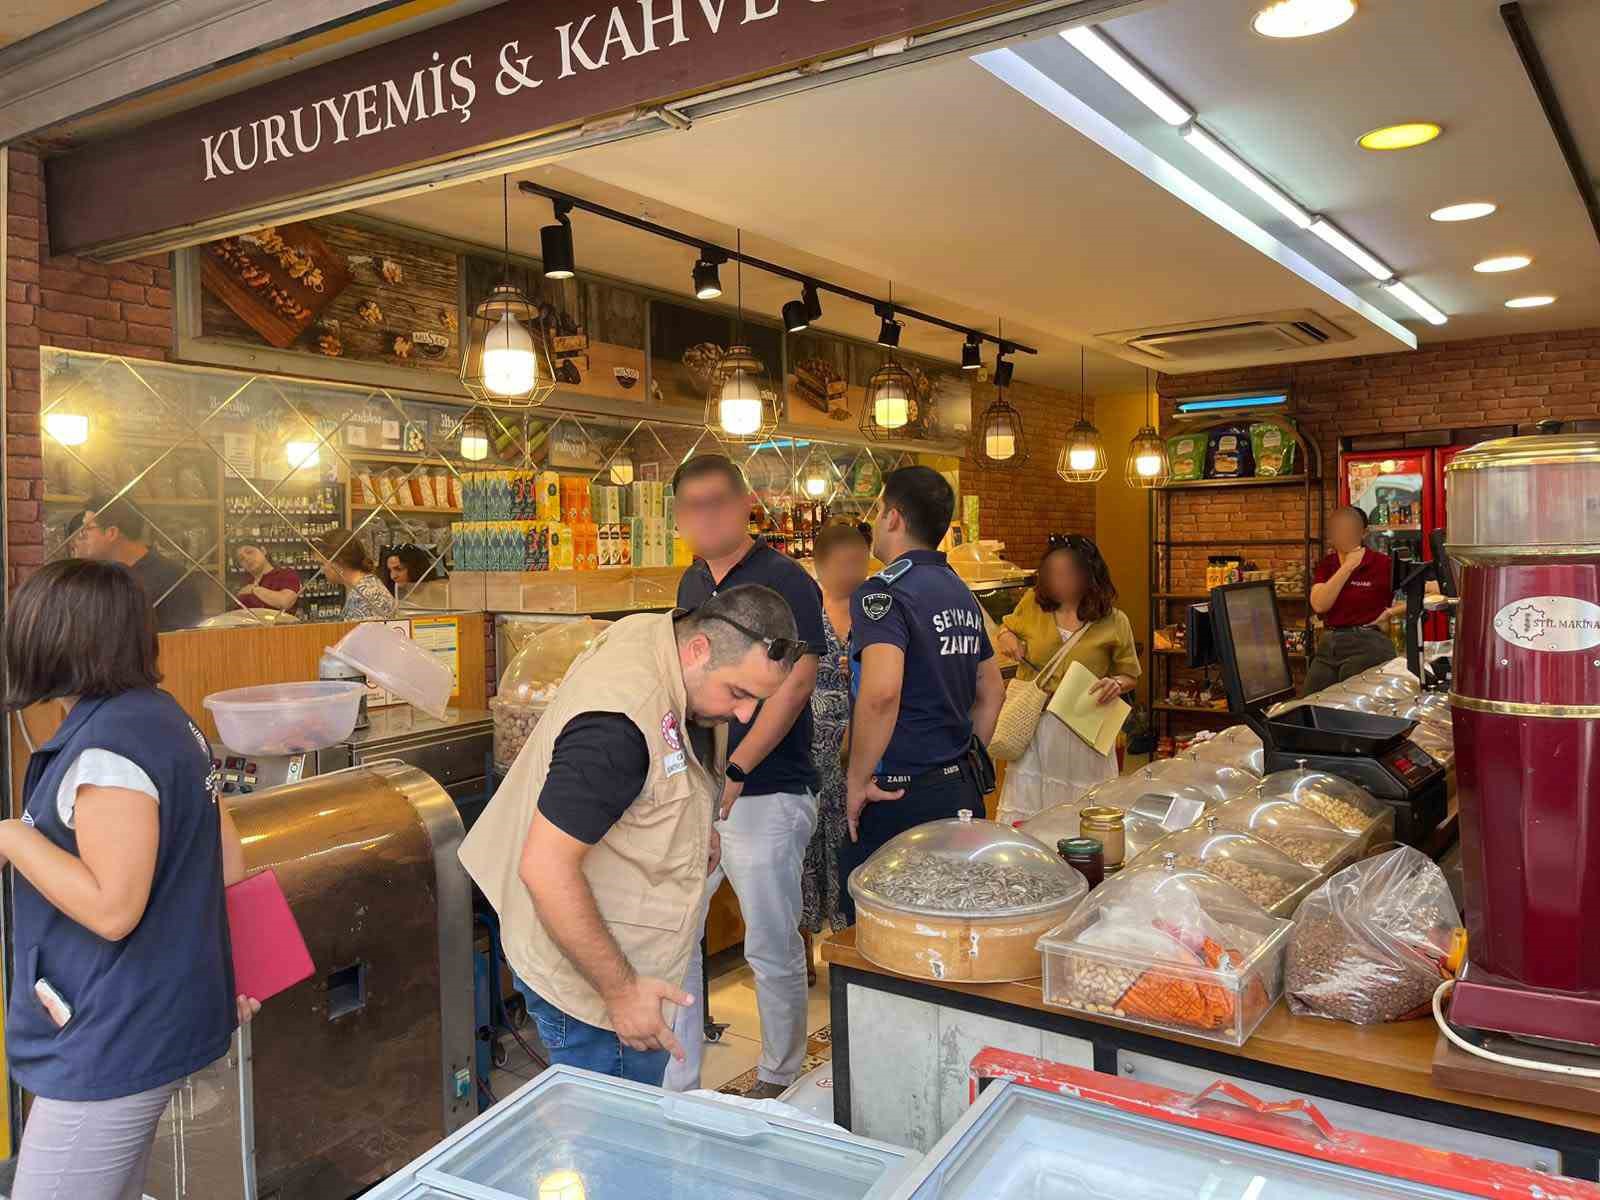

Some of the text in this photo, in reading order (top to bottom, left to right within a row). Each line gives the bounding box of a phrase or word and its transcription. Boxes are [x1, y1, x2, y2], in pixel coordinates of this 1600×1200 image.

[200, 50, 477, 182] KURUYEMİŞ
[495, 40, 544, 96] &
[940, 635, 980, 656] ZAITA
